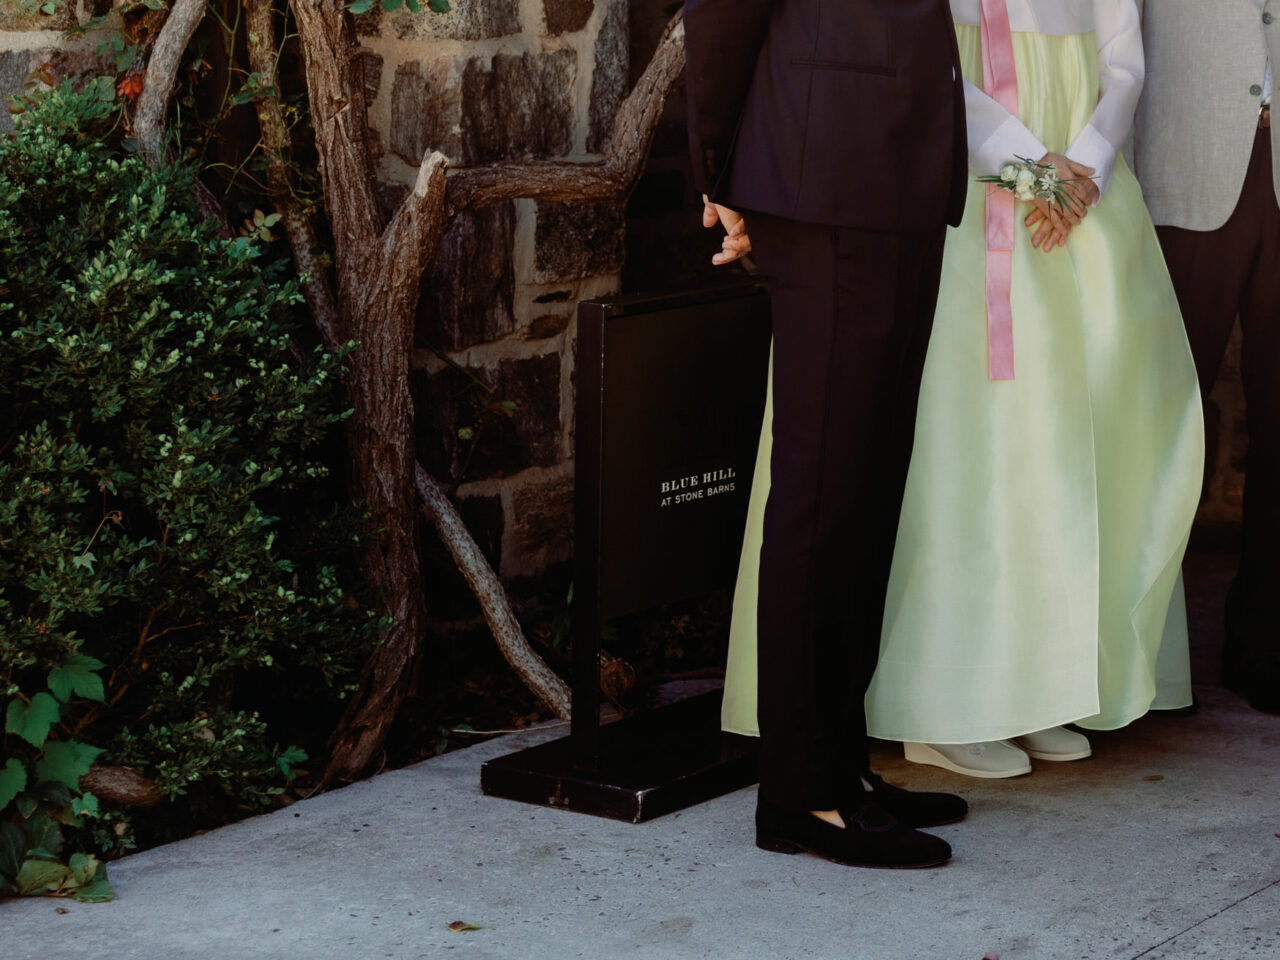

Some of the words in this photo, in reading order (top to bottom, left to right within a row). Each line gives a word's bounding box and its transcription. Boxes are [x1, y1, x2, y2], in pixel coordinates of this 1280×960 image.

[661, 475, 698, 493] BLUE
[703, 468, 736, 484] HILL
[660, 497, 672, 507] AT
[675, 489, 704, 504] STONE
[707, 482, 735, 497] BARNS
